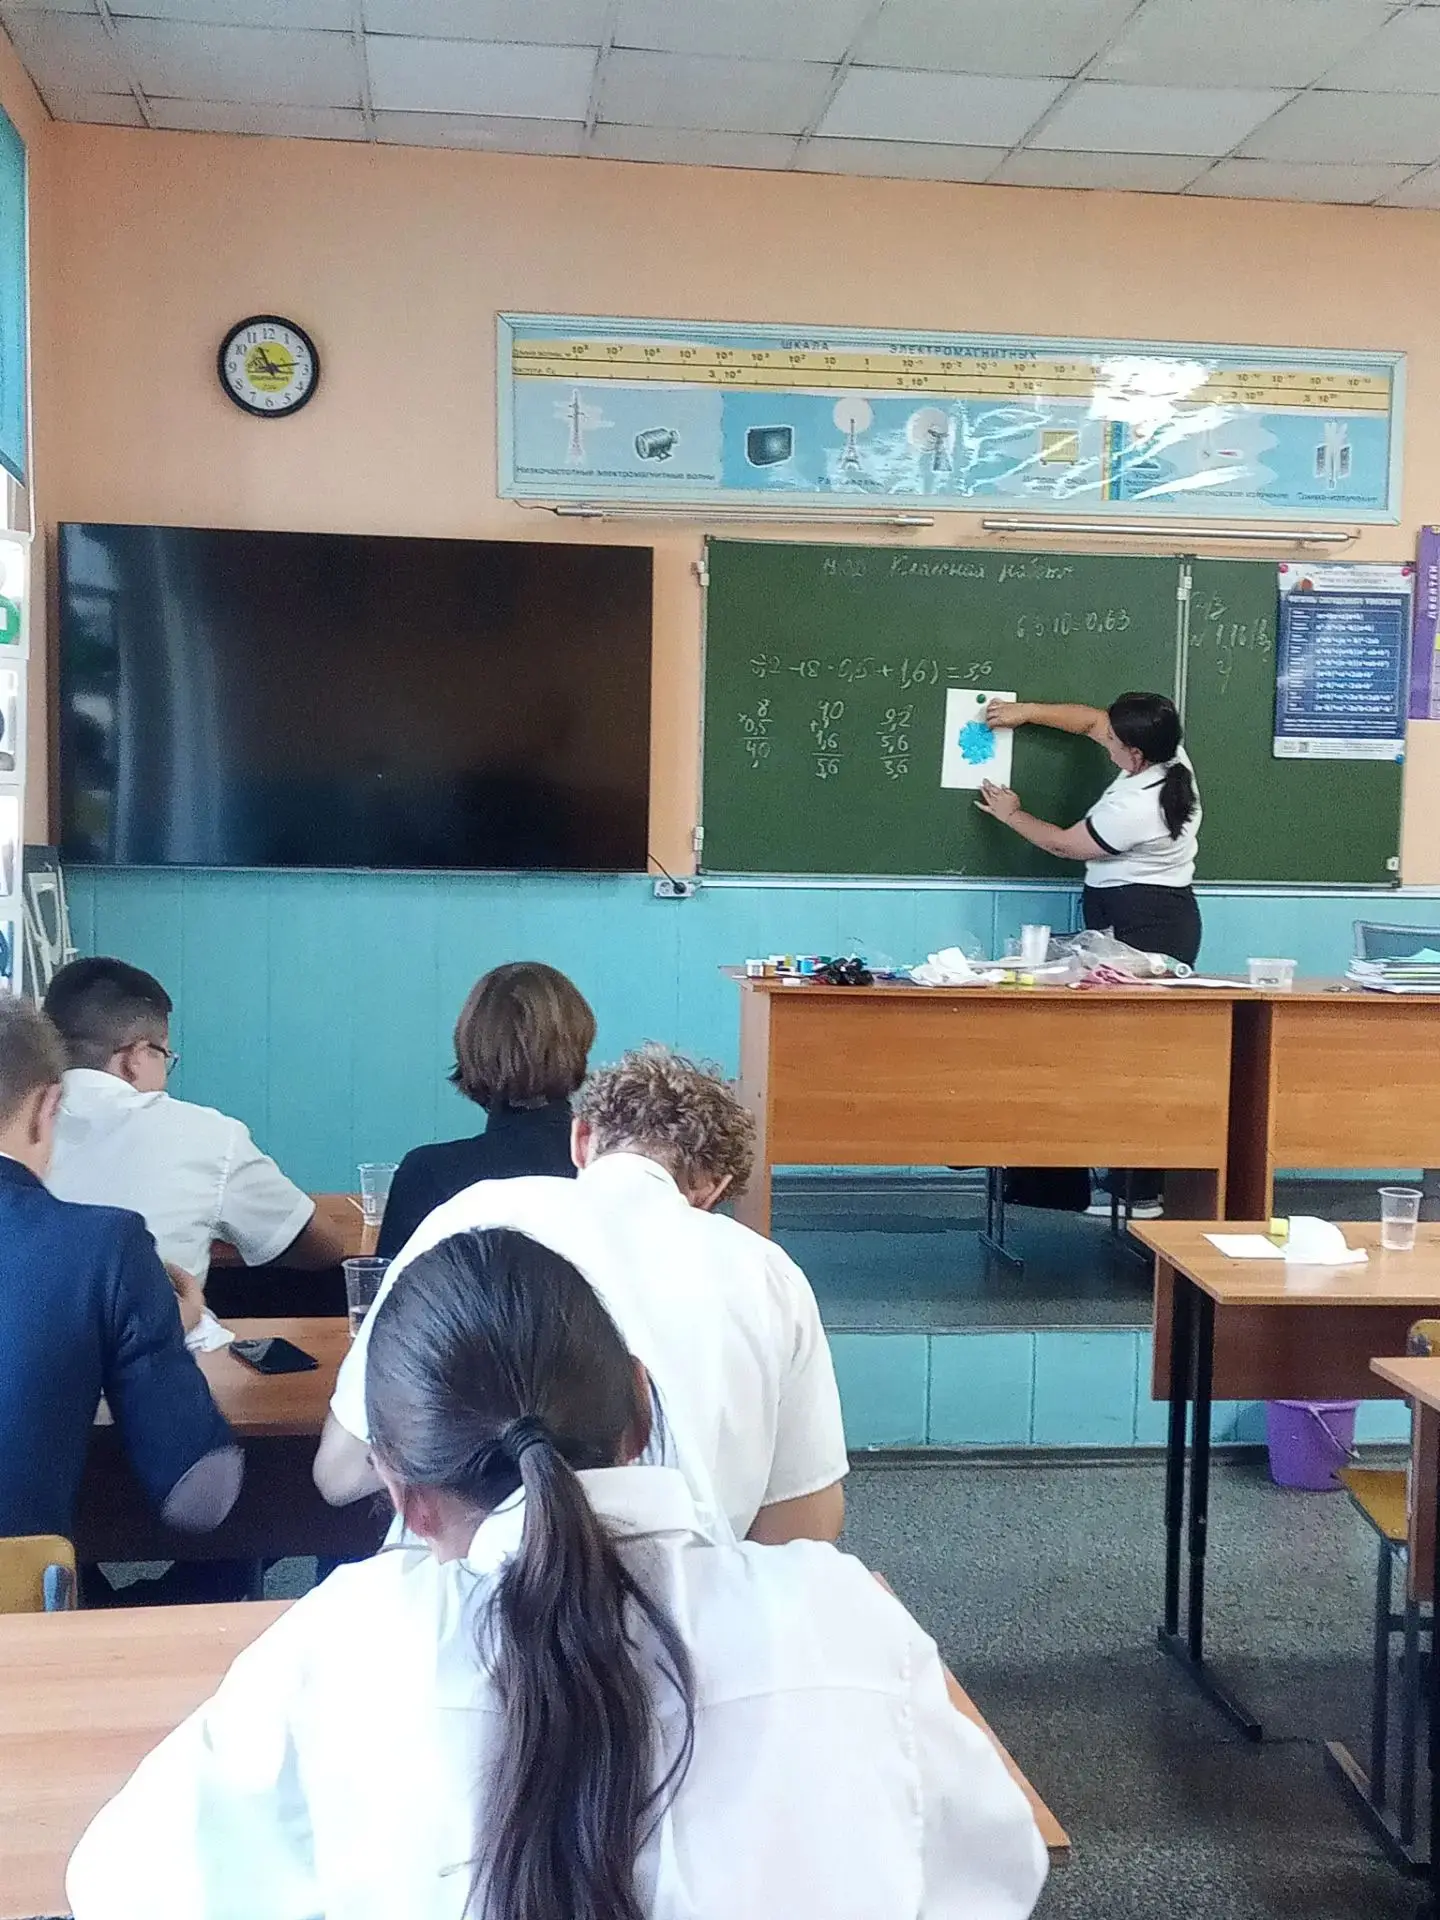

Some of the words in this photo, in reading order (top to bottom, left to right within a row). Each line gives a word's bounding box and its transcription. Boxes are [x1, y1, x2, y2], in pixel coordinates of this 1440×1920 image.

[247, 331, 257, 344] 11
[262, 328, 275, 340] 12
[284, 333, 290, 345] 1
[235, 343, 247, 356] 10
[296, 345, 304, 358] 2
[781, 339, 830, 351] ШКАЛА
[889, 344, 1037, 361] ЭЛЕКТРОМАГНИТНЫХ
[228, 361, 237, 374] 9
[824, 357, 837, 365] 10
[864, 358, 870, 366] 1
[302, 364, 309, 376] 3
[234, 378, 243, 391] 8
[295, 382, 304, 392] 4
[249, 391, 257, 403] 7
[265, 397, 274, 408] 6
[282, 393, 291, 405] 5
[883, 759, 909, 780] 3,6
